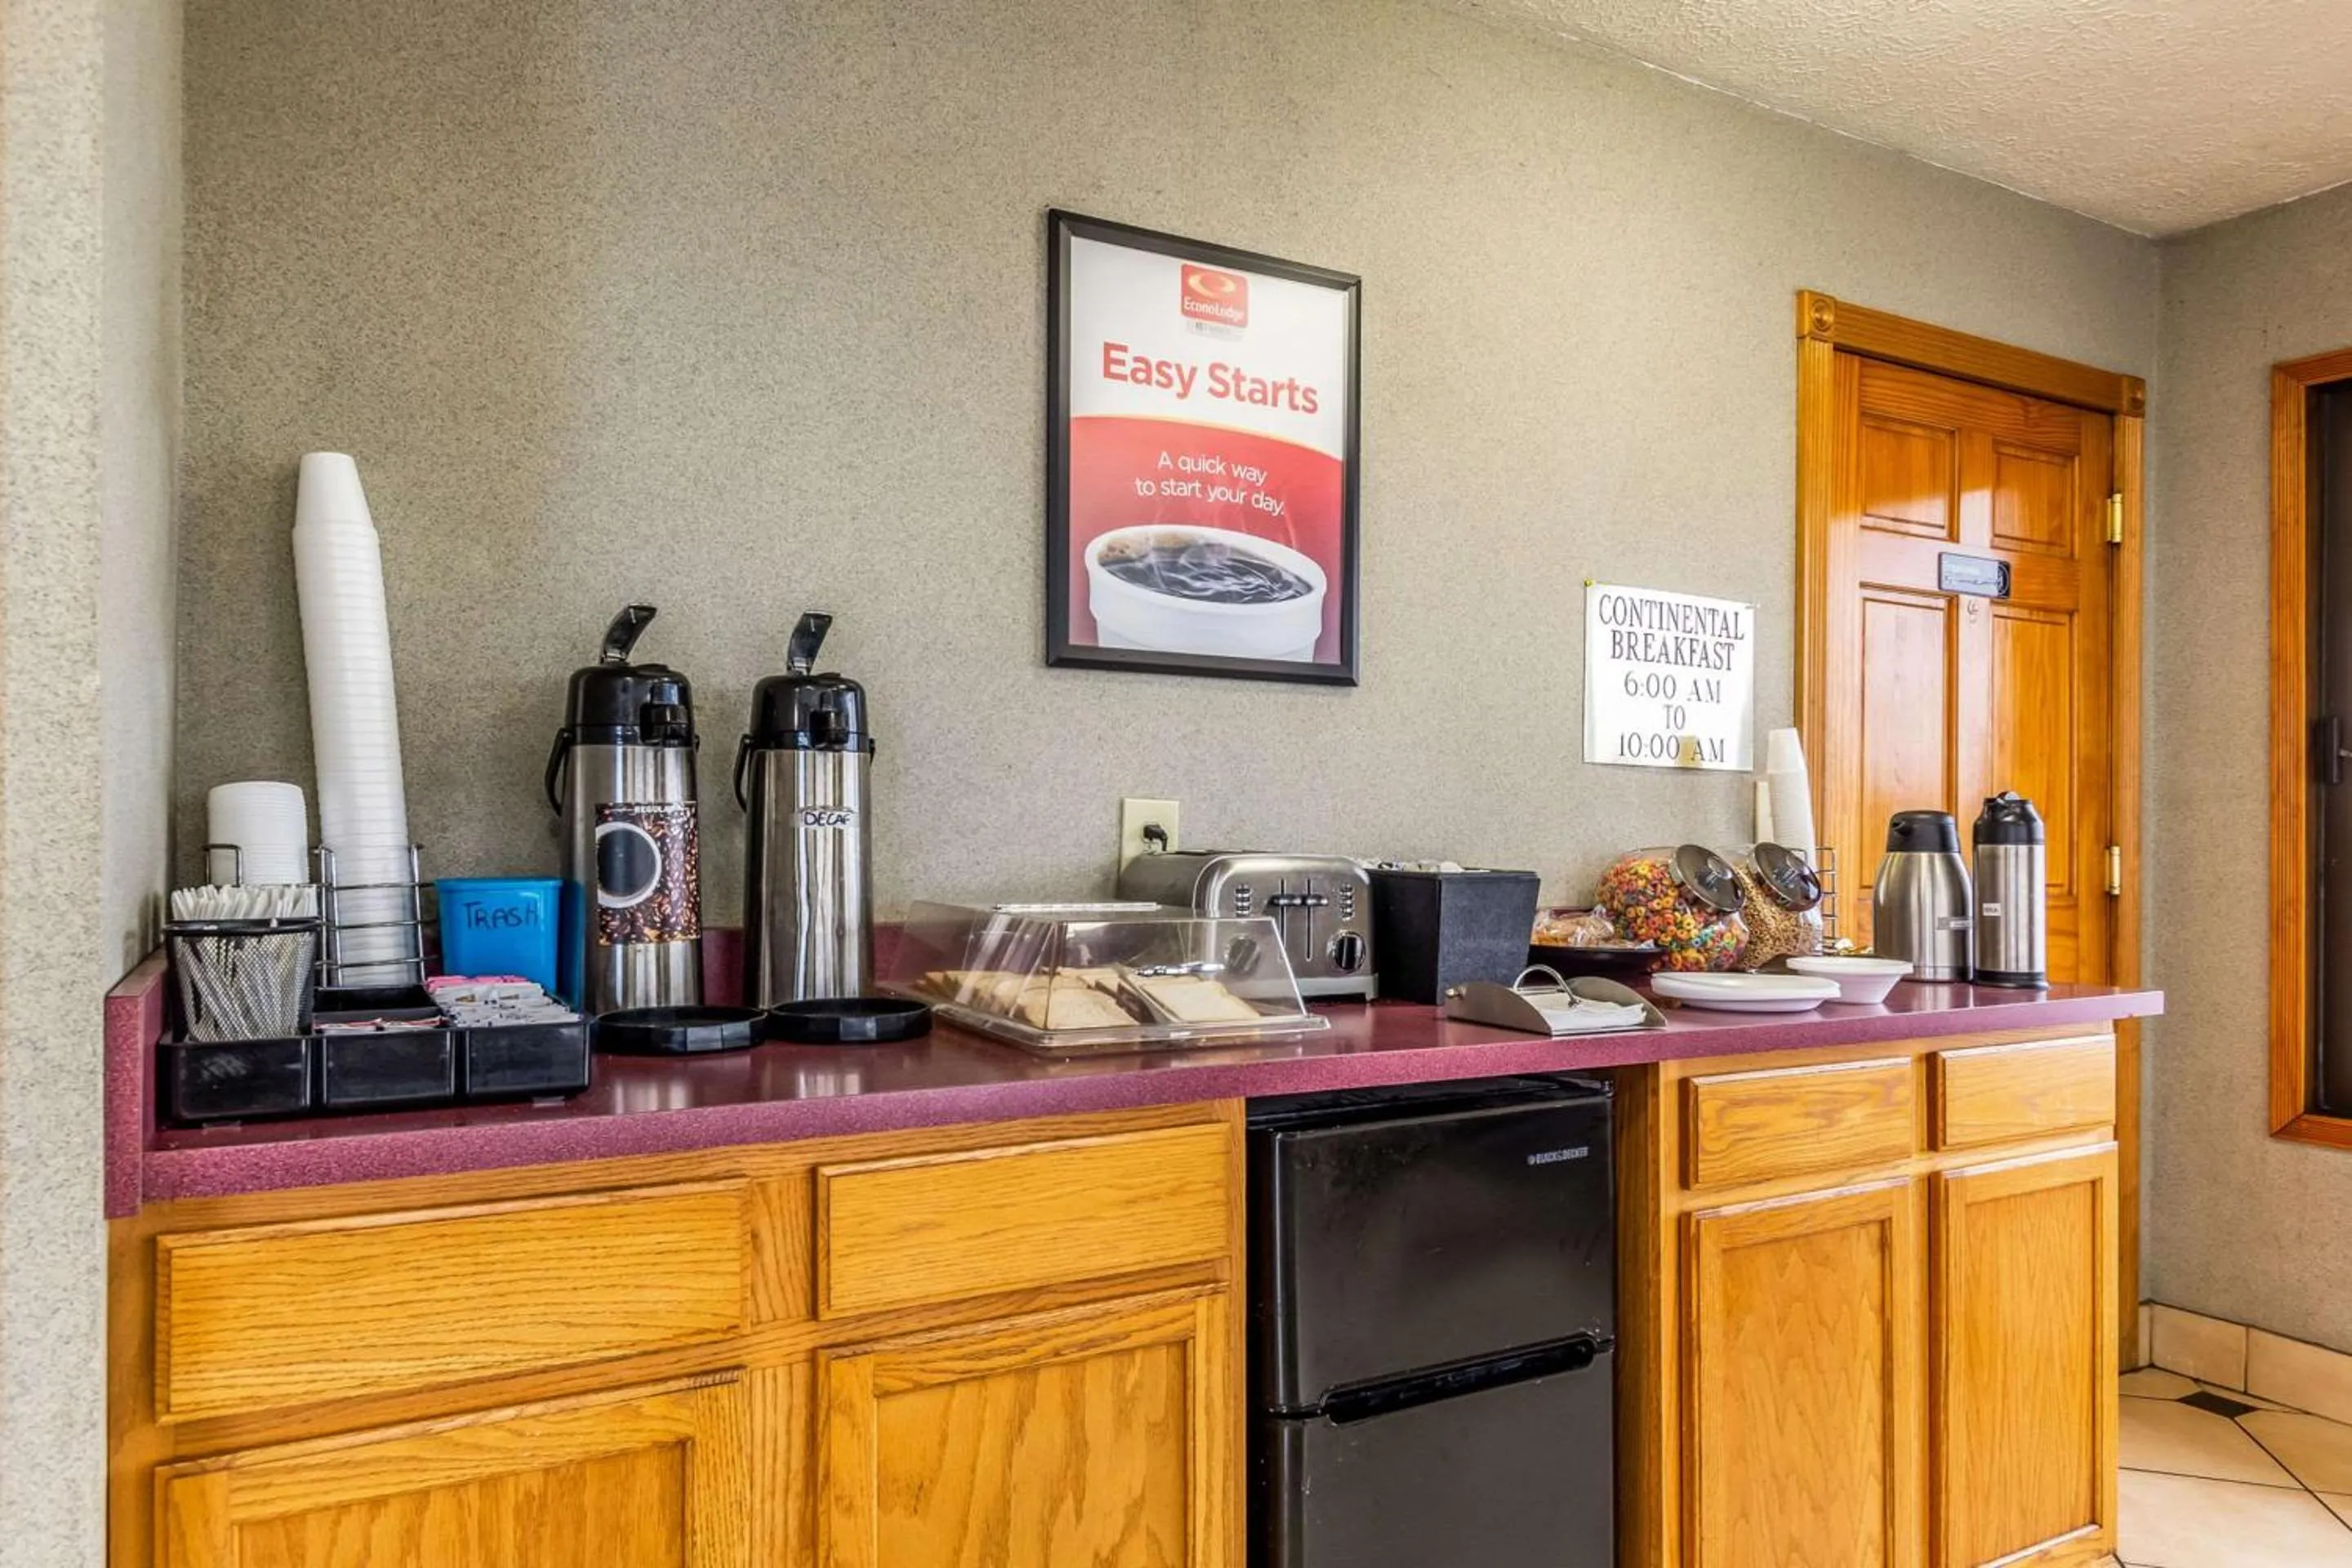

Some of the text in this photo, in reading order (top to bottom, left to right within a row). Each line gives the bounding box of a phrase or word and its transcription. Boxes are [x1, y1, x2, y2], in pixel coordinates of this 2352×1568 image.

[1102, 341, 1318, 414] Easy Starts
[1156, 450, 1267, 486] A quick way
[1135, 477, 1286, 516] to start your day.
[1598, 593, 1745, 641] CONTINENTAL
[1610, 629, 1735, 671] BREAKFAST
[1624, 670, 1722, 704] 6:00 AM
[1663, 703, 1686, 730] TO
[1619, 732, 1725, 763] 10:00 AM
[804, 811, 851, 826] DECAF
[463, 900, 540, 929] TRASH
